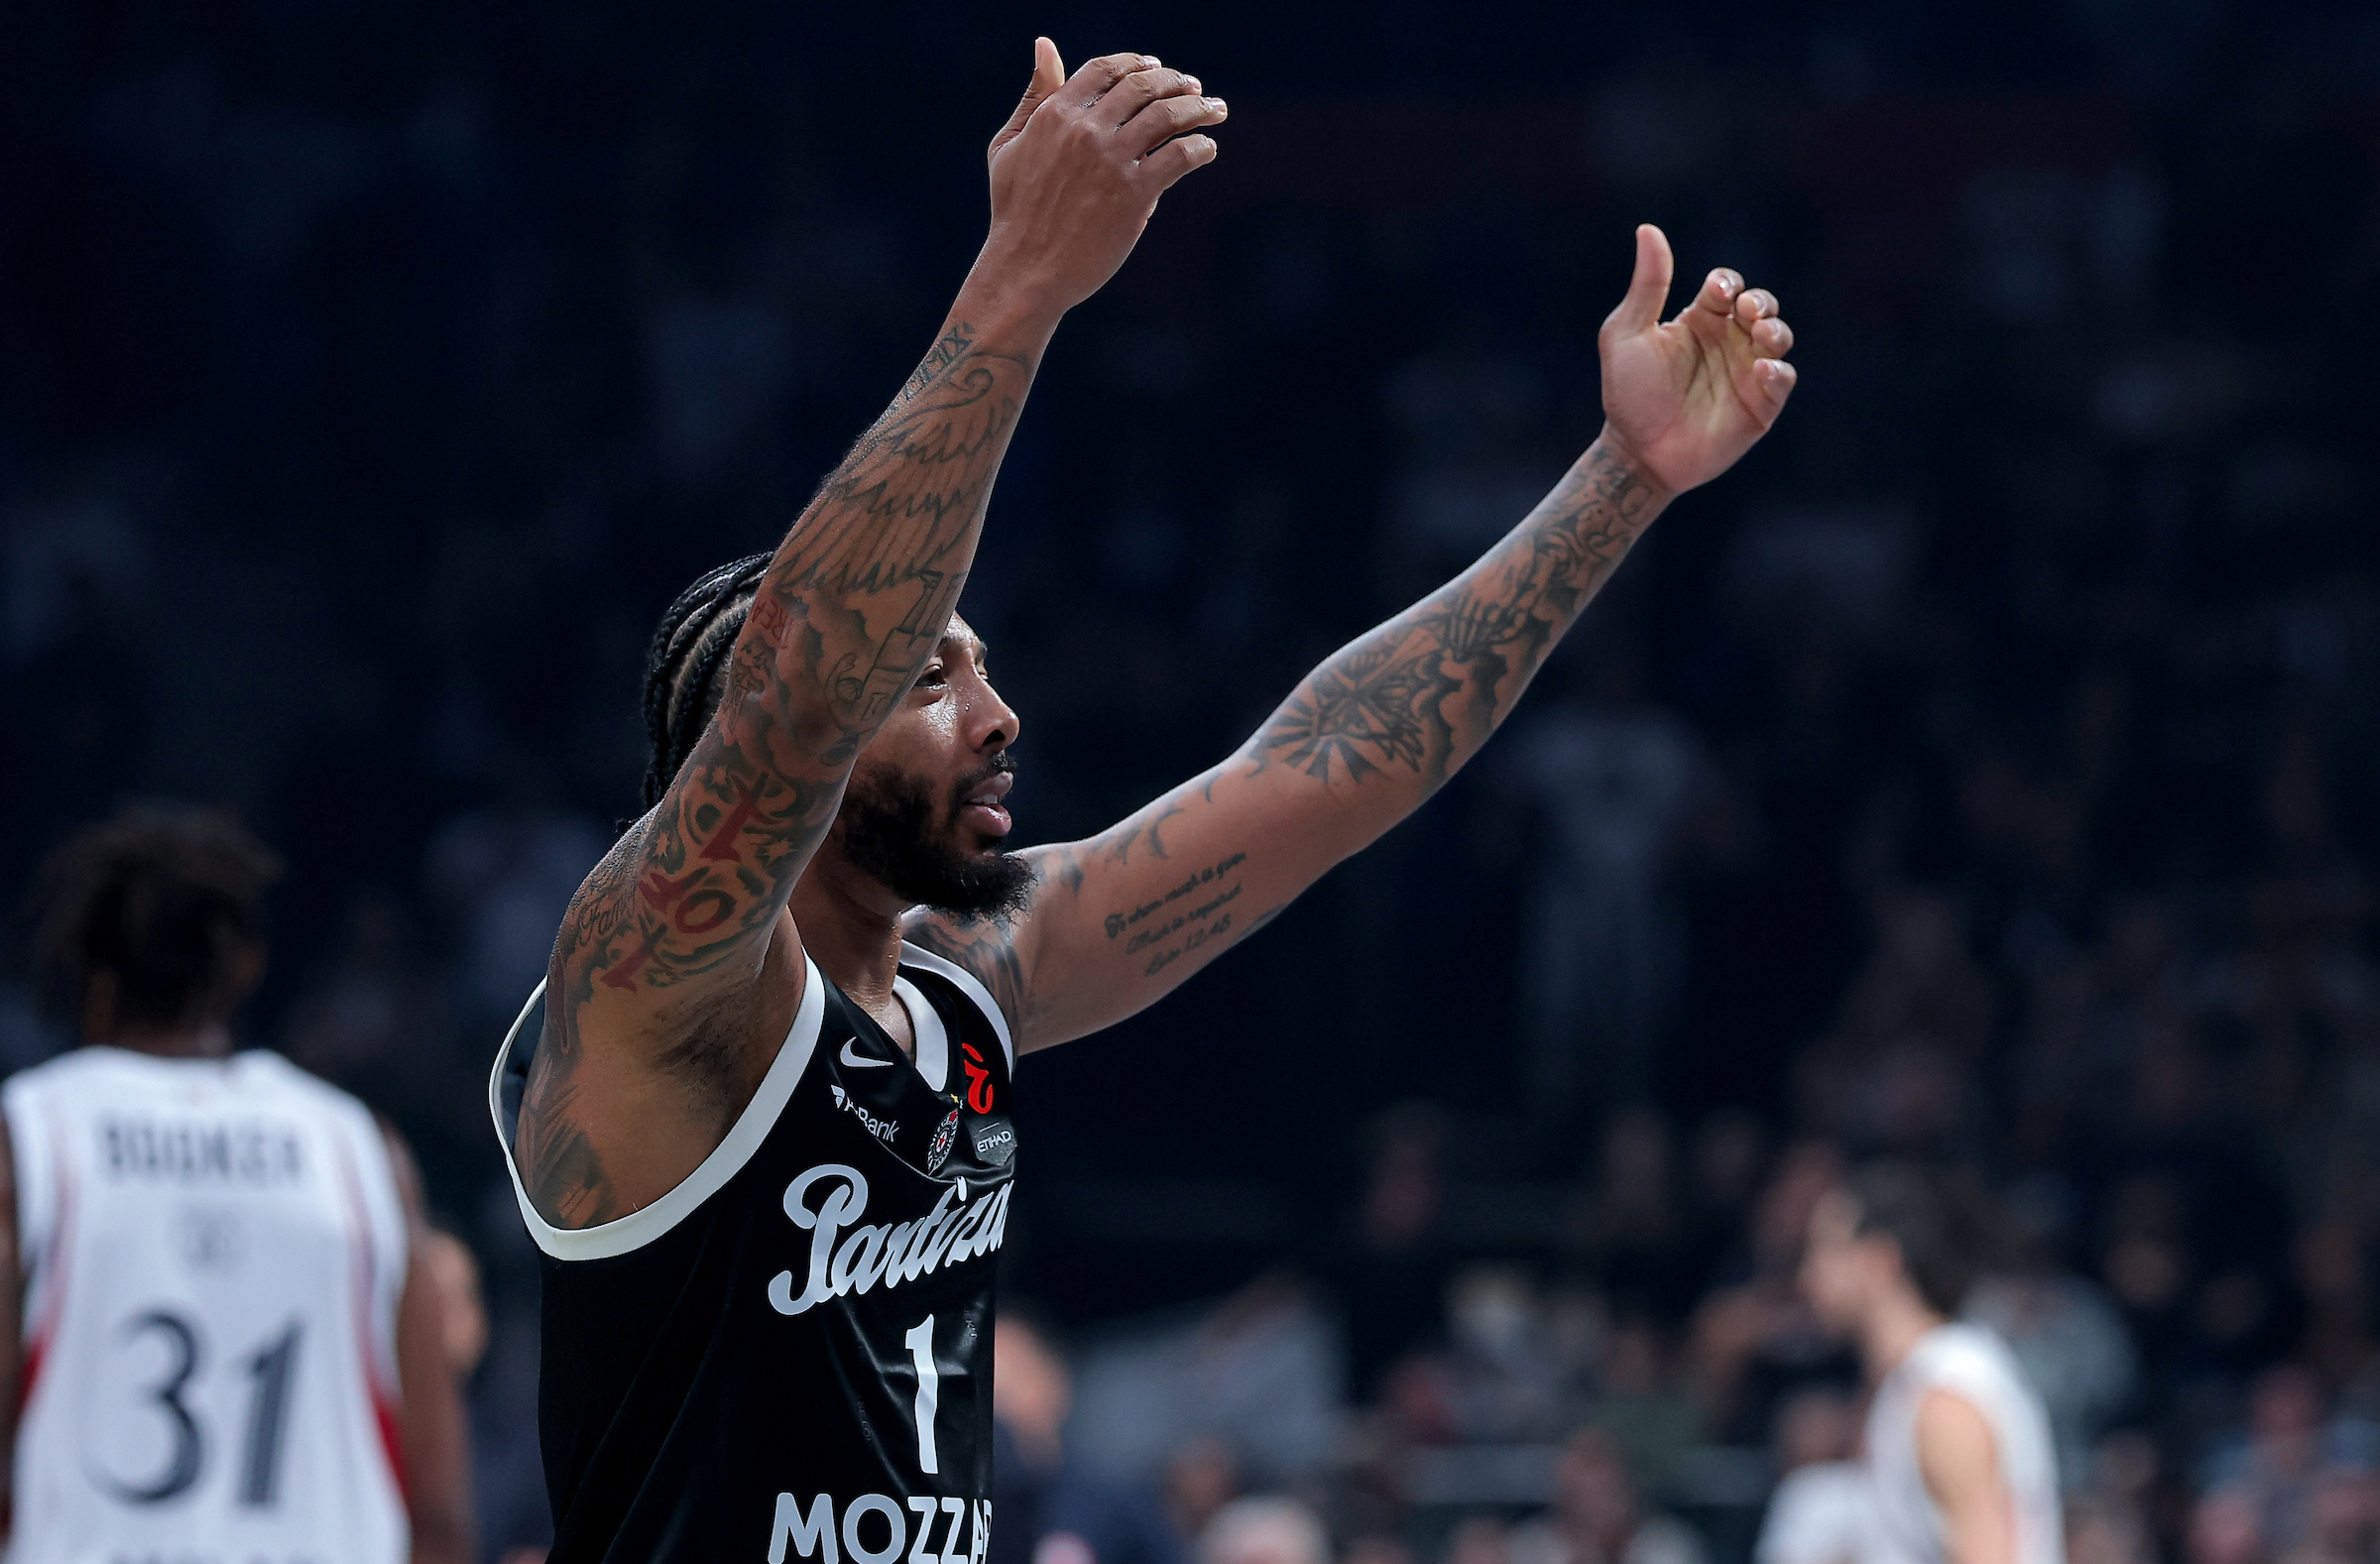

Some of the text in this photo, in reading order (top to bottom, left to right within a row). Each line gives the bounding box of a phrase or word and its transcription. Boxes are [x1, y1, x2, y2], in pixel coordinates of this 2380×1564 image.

[977, 1131, 1012, 1152] ETIHAD
[81, 1307, 305, 1512] 31
[904, 1313, 939, 1475] 1
